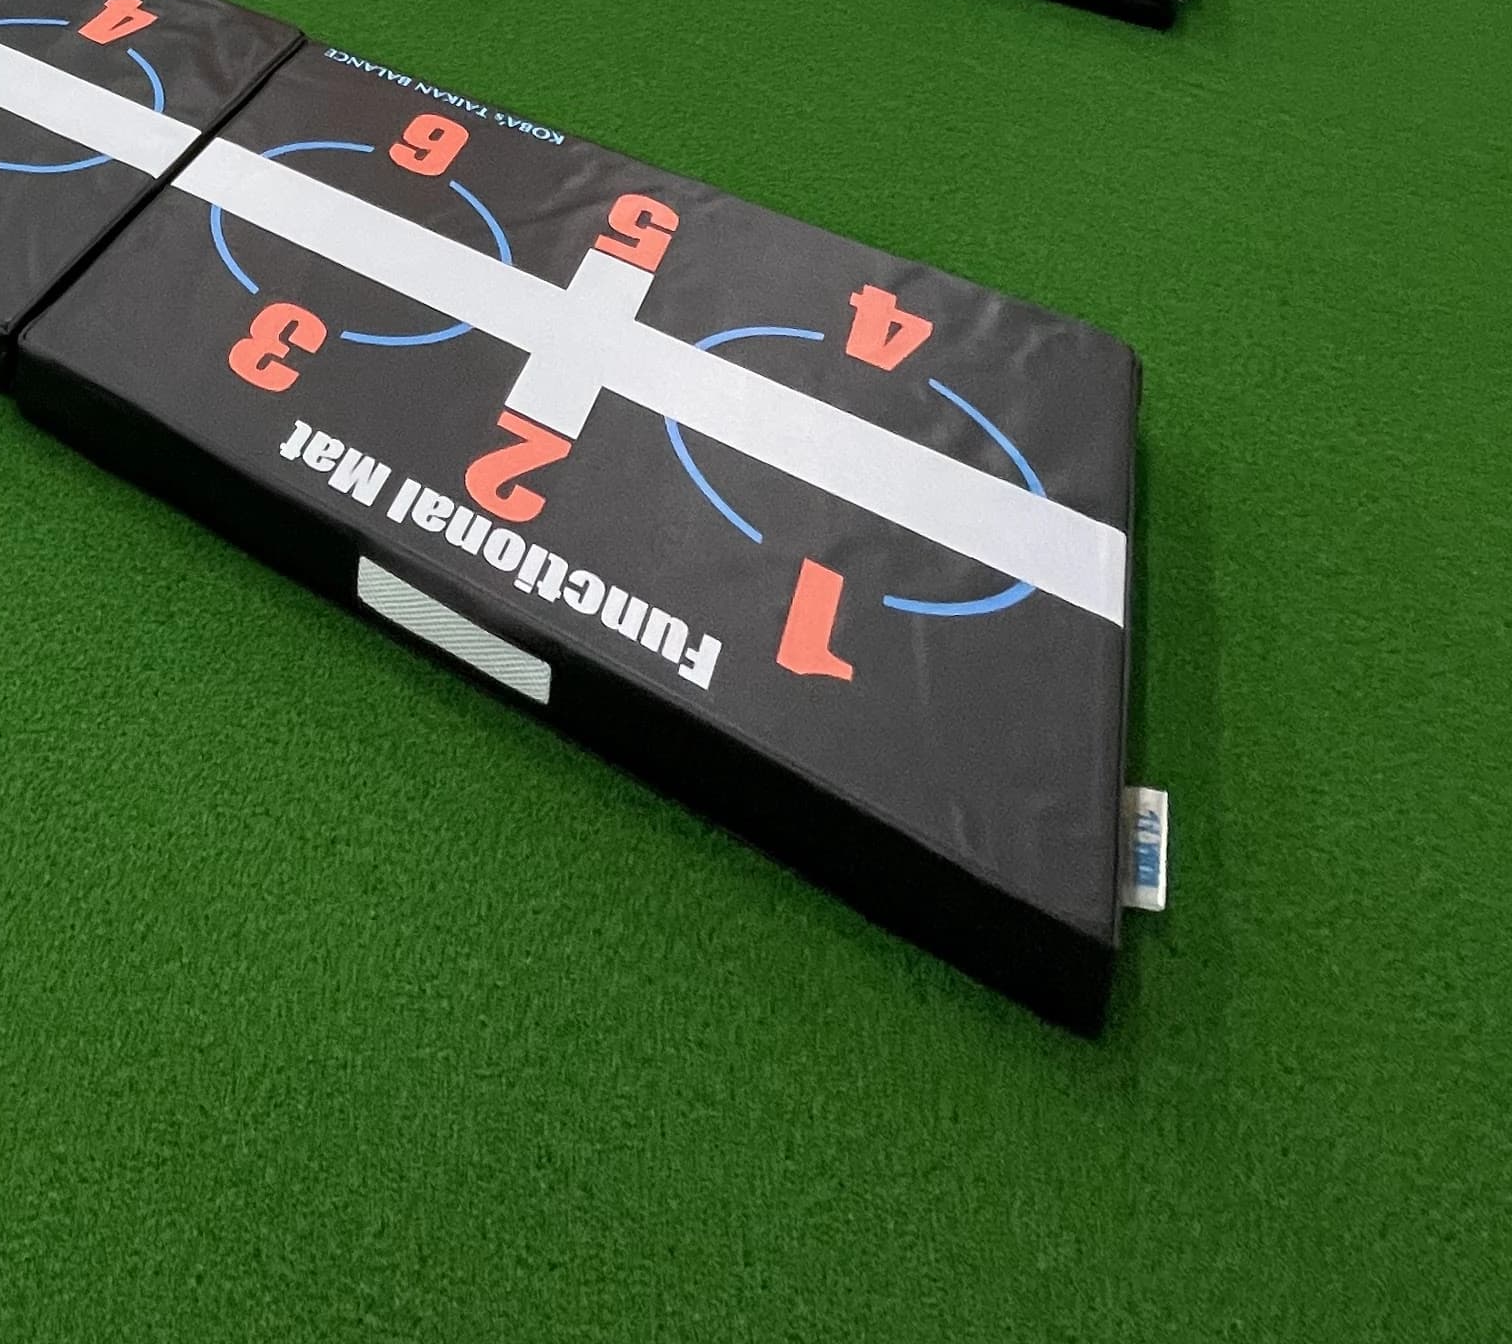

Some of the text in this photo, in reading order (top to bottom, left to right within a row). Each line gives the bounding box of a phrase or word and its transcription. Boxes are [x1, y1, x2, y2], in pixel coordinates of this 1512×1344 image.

[323, 47, 413, 88] BALANCE
[414, 81, 489, 120] TAIKAN
[388, 113, 471, 178] 6
[593, 192, 681, 274] 5
[226, 300, 329, 394] 3
[844, 283, 934, 373] 4
[463, 409, 573, 524] 2
[278, 418, 724, 691] Functional Mat
[774, 557, 856, 682] 1
